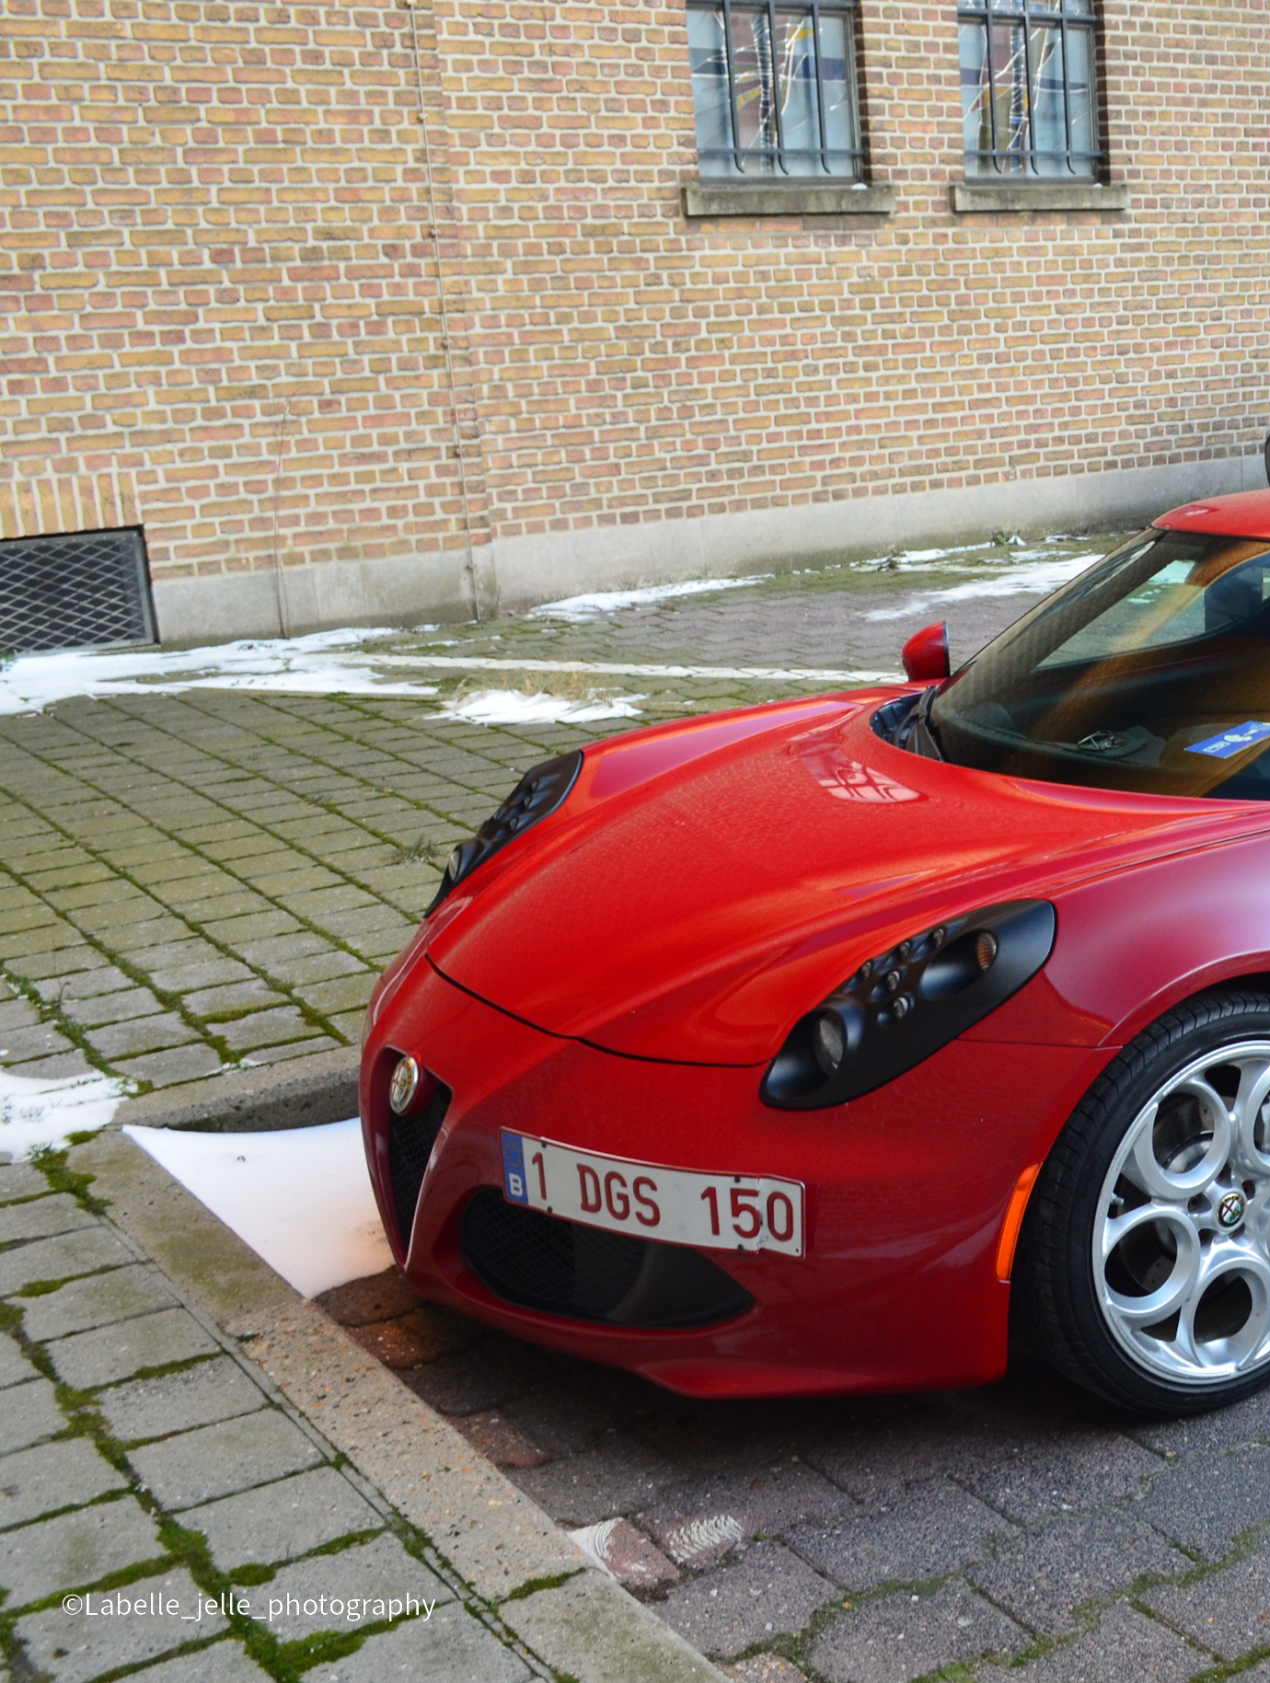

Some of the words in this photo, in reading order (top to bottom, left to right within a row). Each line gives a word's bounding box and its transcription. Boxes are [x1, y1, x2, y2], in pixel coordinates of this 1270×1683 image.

[508, 1173, 523, 1197] B
[531, 1152, 547, 1201] 1
[576, 1163, 661, 1228] DGS
[700, 1186, 794, 1242] 150
